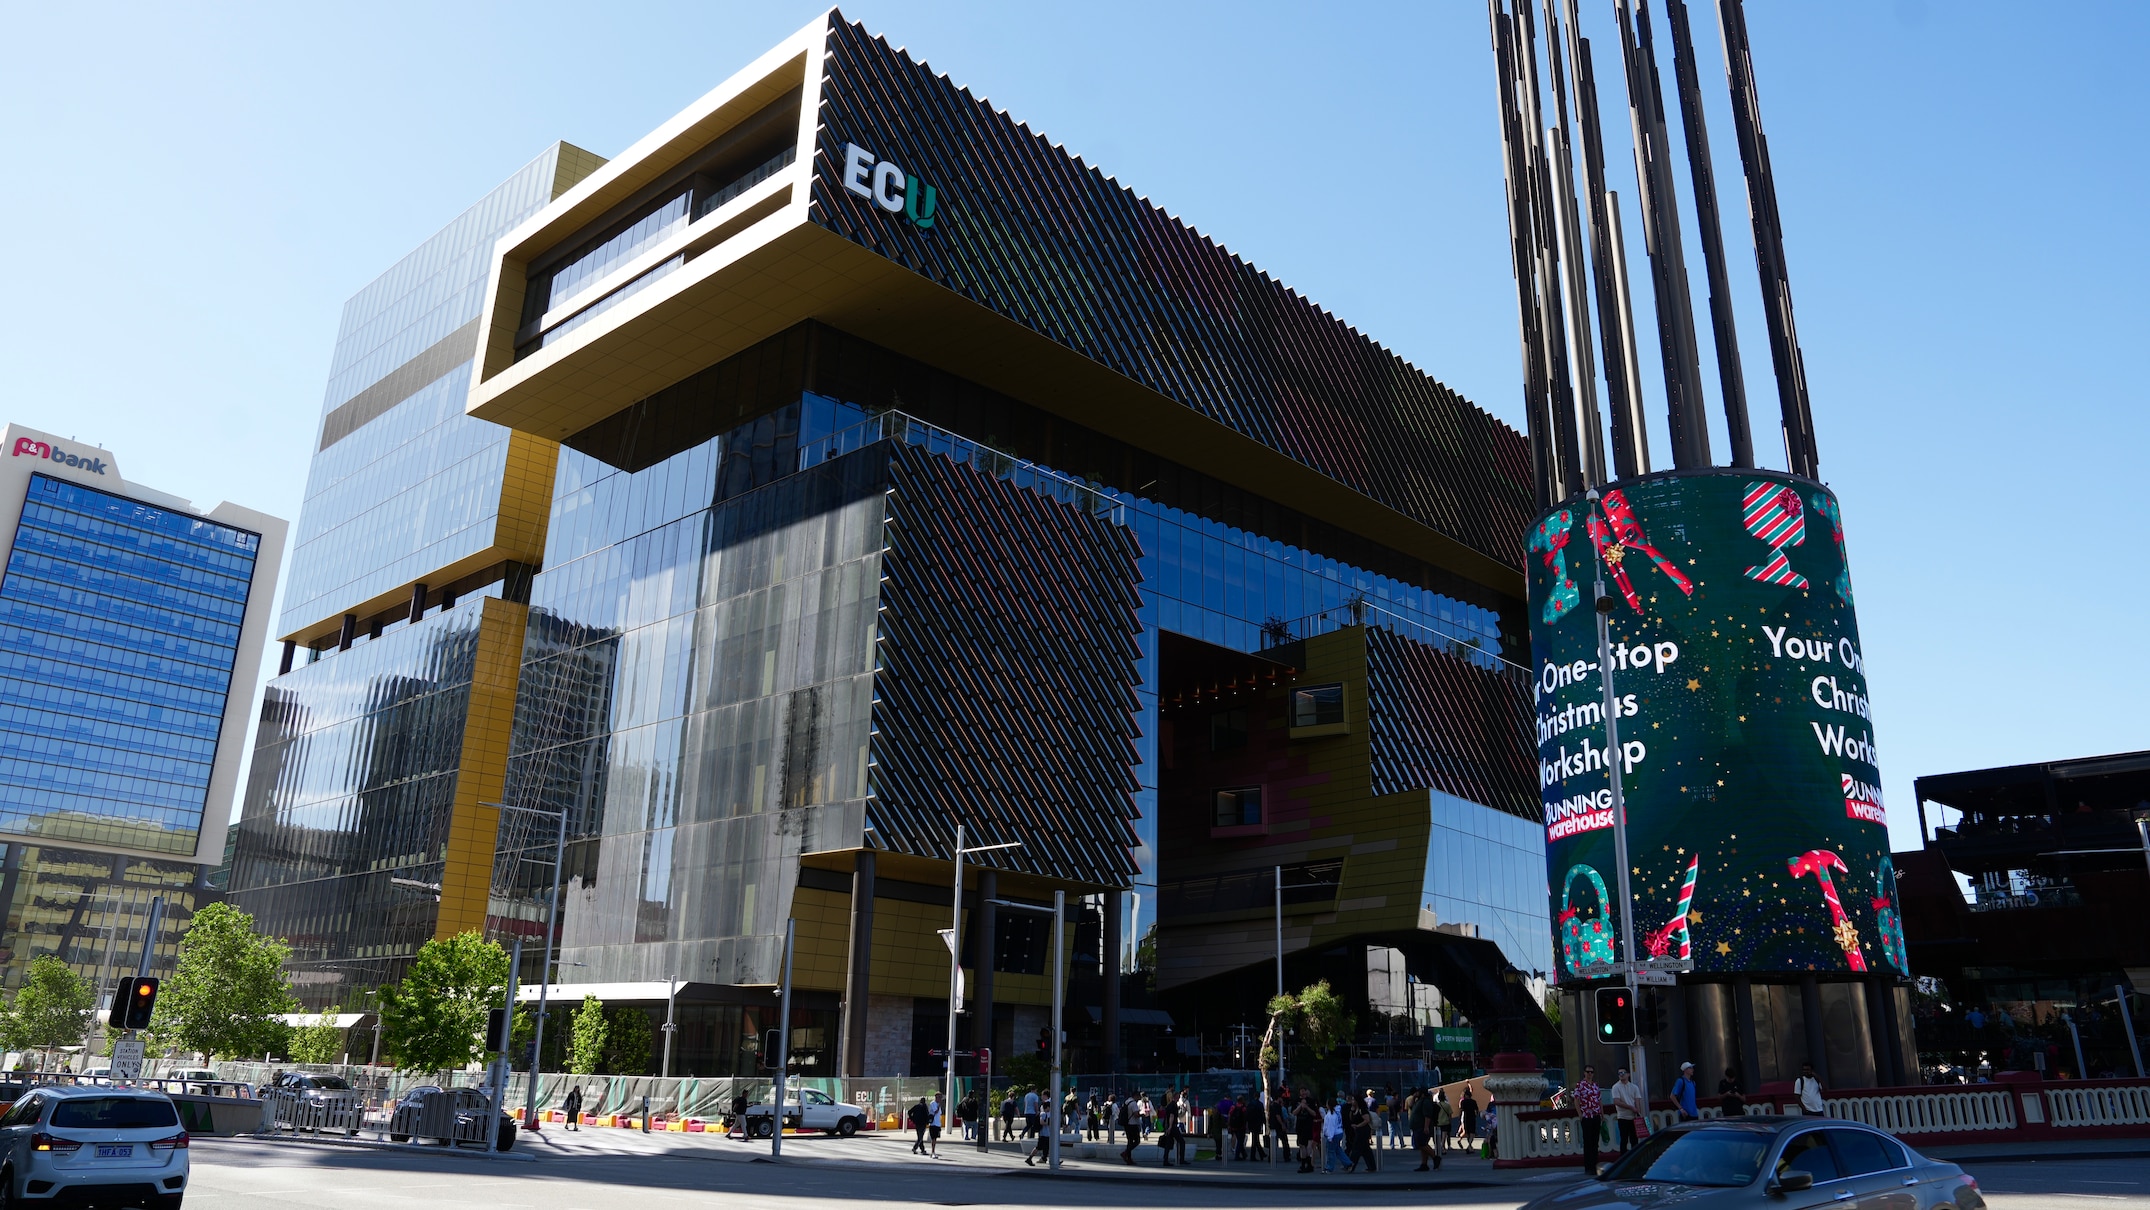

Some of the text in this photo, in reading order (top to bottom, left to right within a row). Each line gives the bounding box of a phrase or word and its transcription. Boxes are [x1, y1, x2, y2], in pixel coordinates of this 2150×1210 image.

[844, 142, 936, 228] ECU
[51, 446, 107, 475] bank
[1761, 626, 1833, 663] Your
[1543, 641, 1679, 694] One-Stop
[1545, 788, 1625, 826] BUNNING
[1579, 966, 1609, 974] WELLINGTON
[1649, 961, 1683, 969] WELLINGTON
[856, 1091, 873, 1102] ECU
